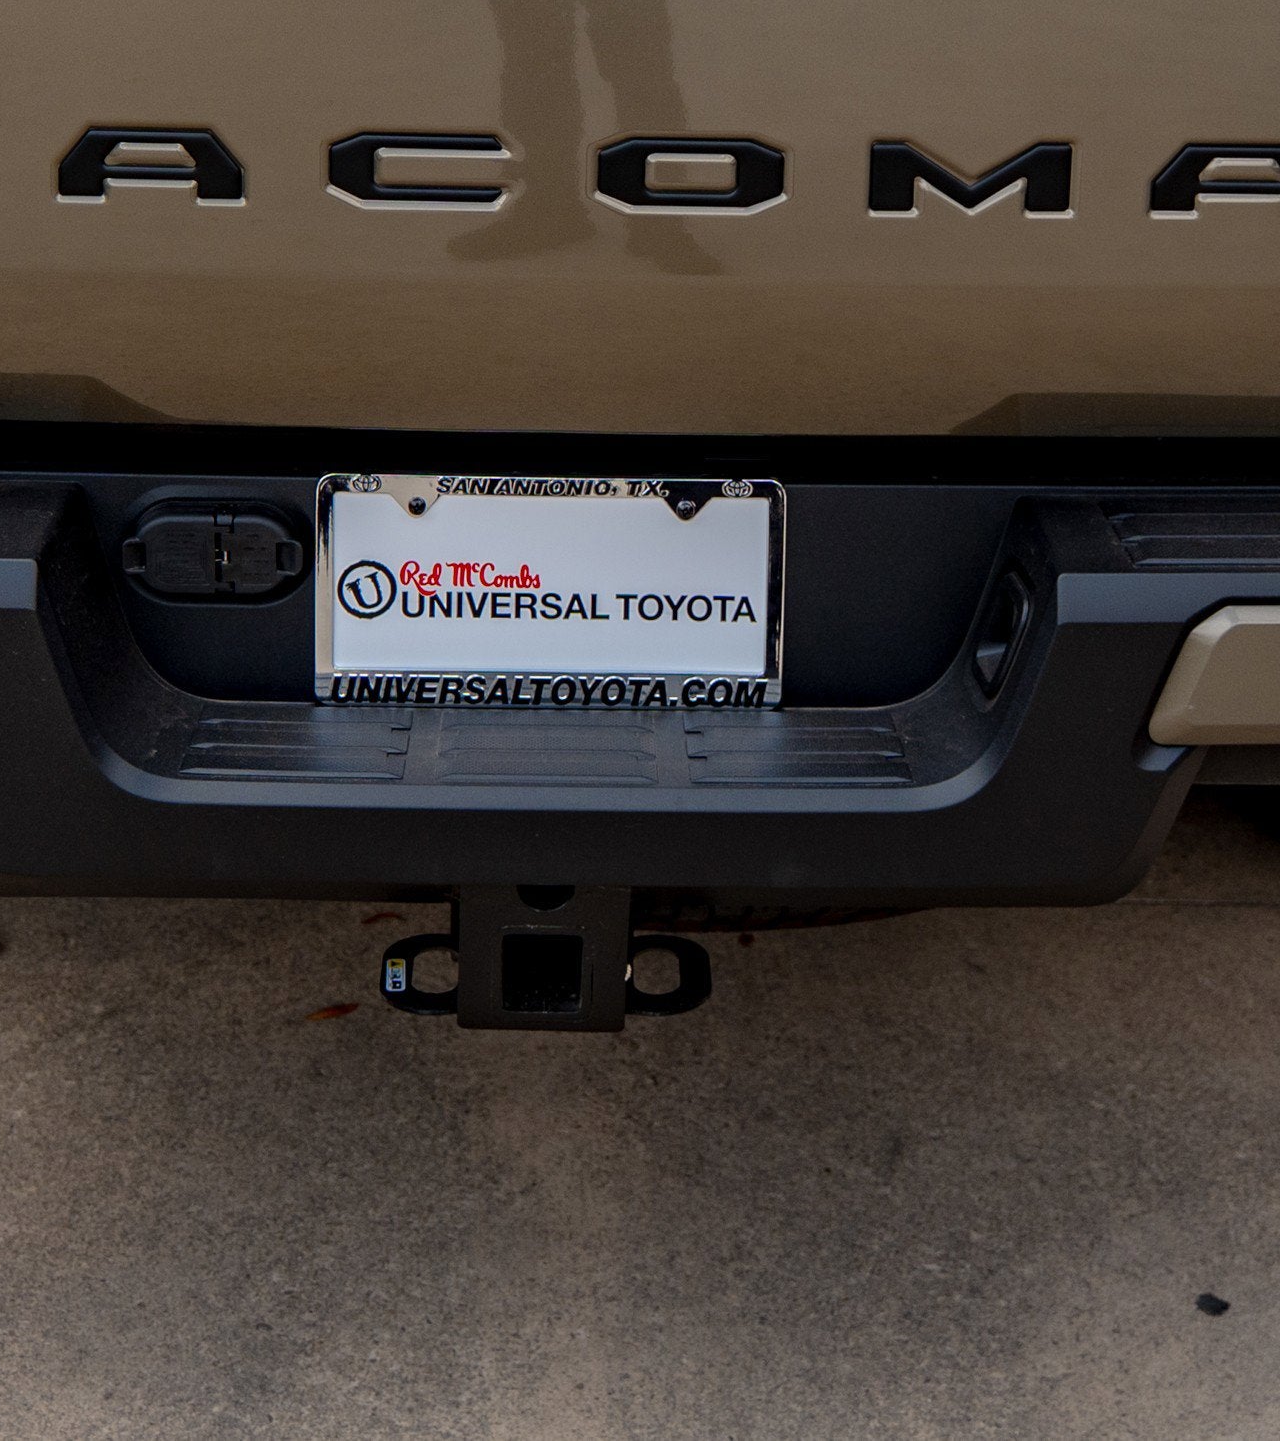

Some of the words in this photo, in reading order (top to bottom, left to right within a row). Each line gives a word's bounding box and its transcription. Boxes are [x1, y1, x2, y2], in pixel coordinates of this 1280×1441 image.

[436, 476, 490, 496] SAN
[400, 560, 443, 596] Red
[446, 562, 541, 589] McCombs
[401, 592, 610, 620] UNIVERSAL
[616, 594, 757, 622] TOYOTA
[331, 673, 769, 708] UNIVERSALTOYOTA.COM
